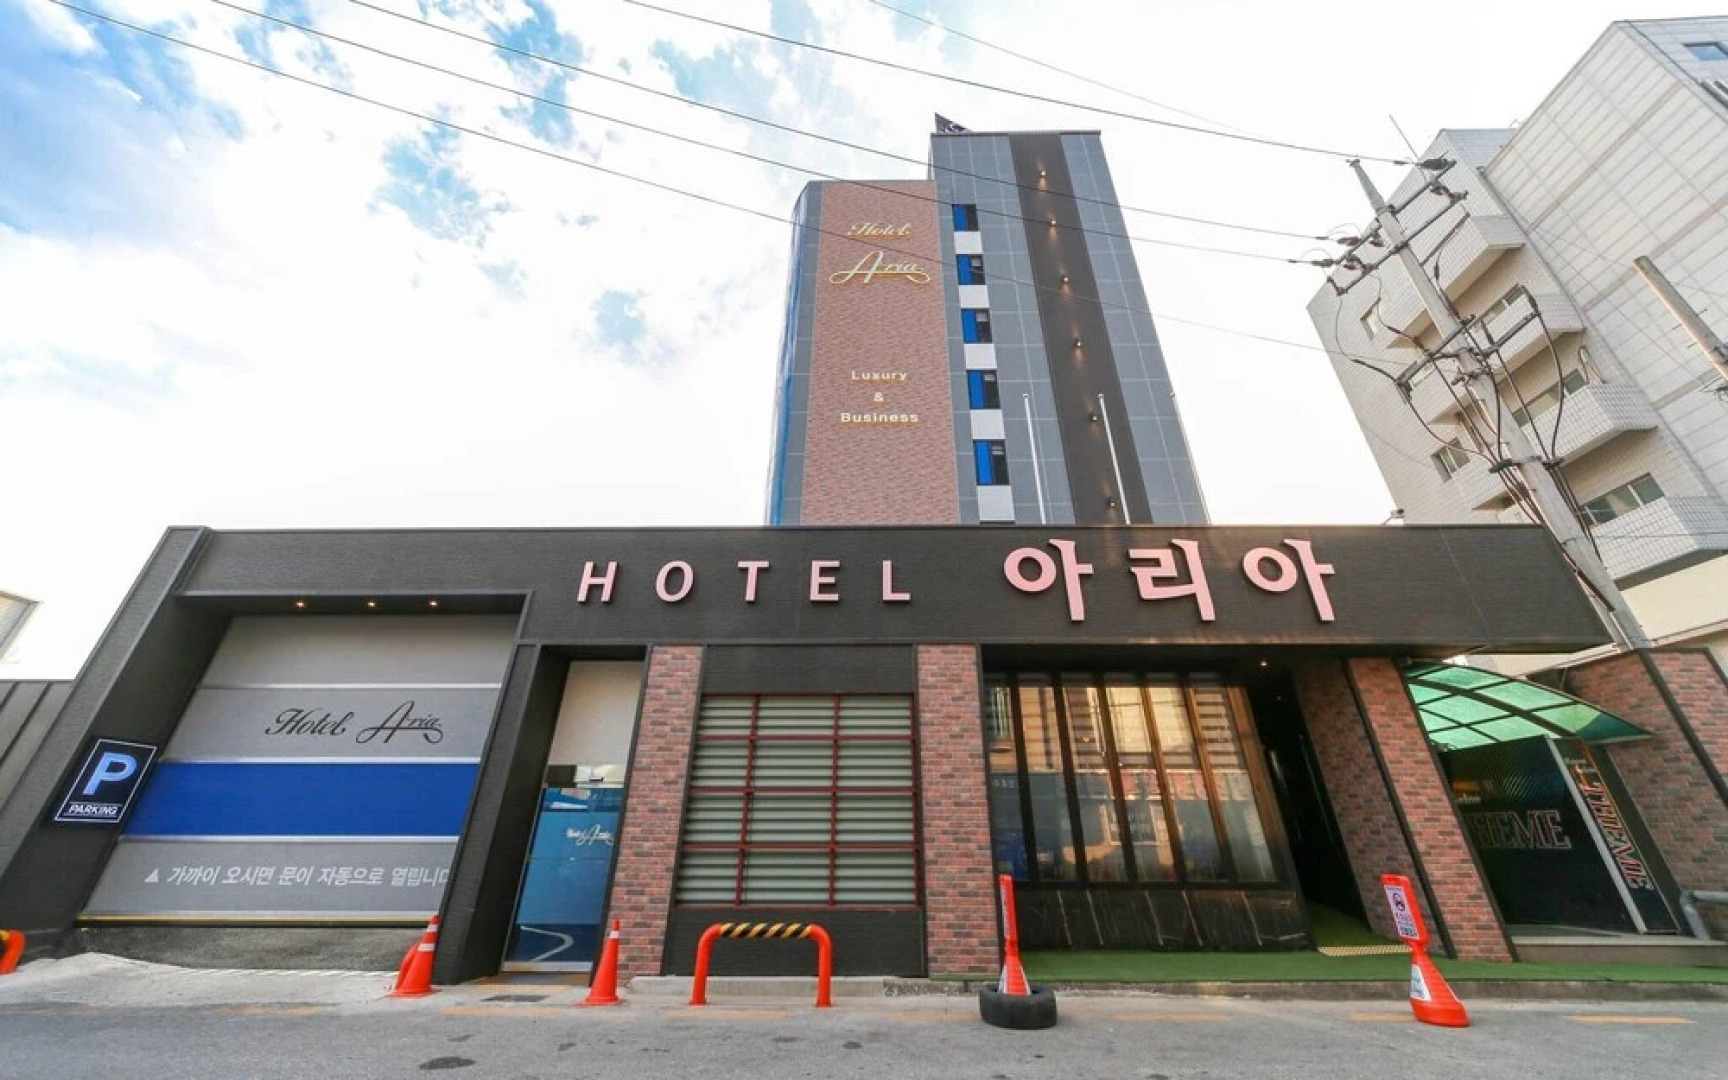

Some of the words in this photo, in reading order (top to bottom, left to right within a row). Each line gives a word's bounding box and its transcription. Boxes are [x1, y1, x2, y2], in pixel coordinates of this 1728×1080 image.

[847, 222, 914, 236] Hotel
[829, 250, 931, 284] Aria
[851, 369, 909, 381] Luxury
[874, 391, 884, 402] &
[840, 412, 919, 423] Business
[576, 559, 912, 603] HOTEL
[1003, 538, 1336, 622] 아리아
[264, 707, 355, 736] Hotel
[355, 699, 443, 744] Aria
[82, 751, 138, 796] P
[68, 804, 119, 816] PARKING
[166, 865, 221, 886] 가까이
[220, 865, 275, 886] 오시면
[278, 865, 314, 886] 문이
[317, 866, 384, 886] 자동으로
